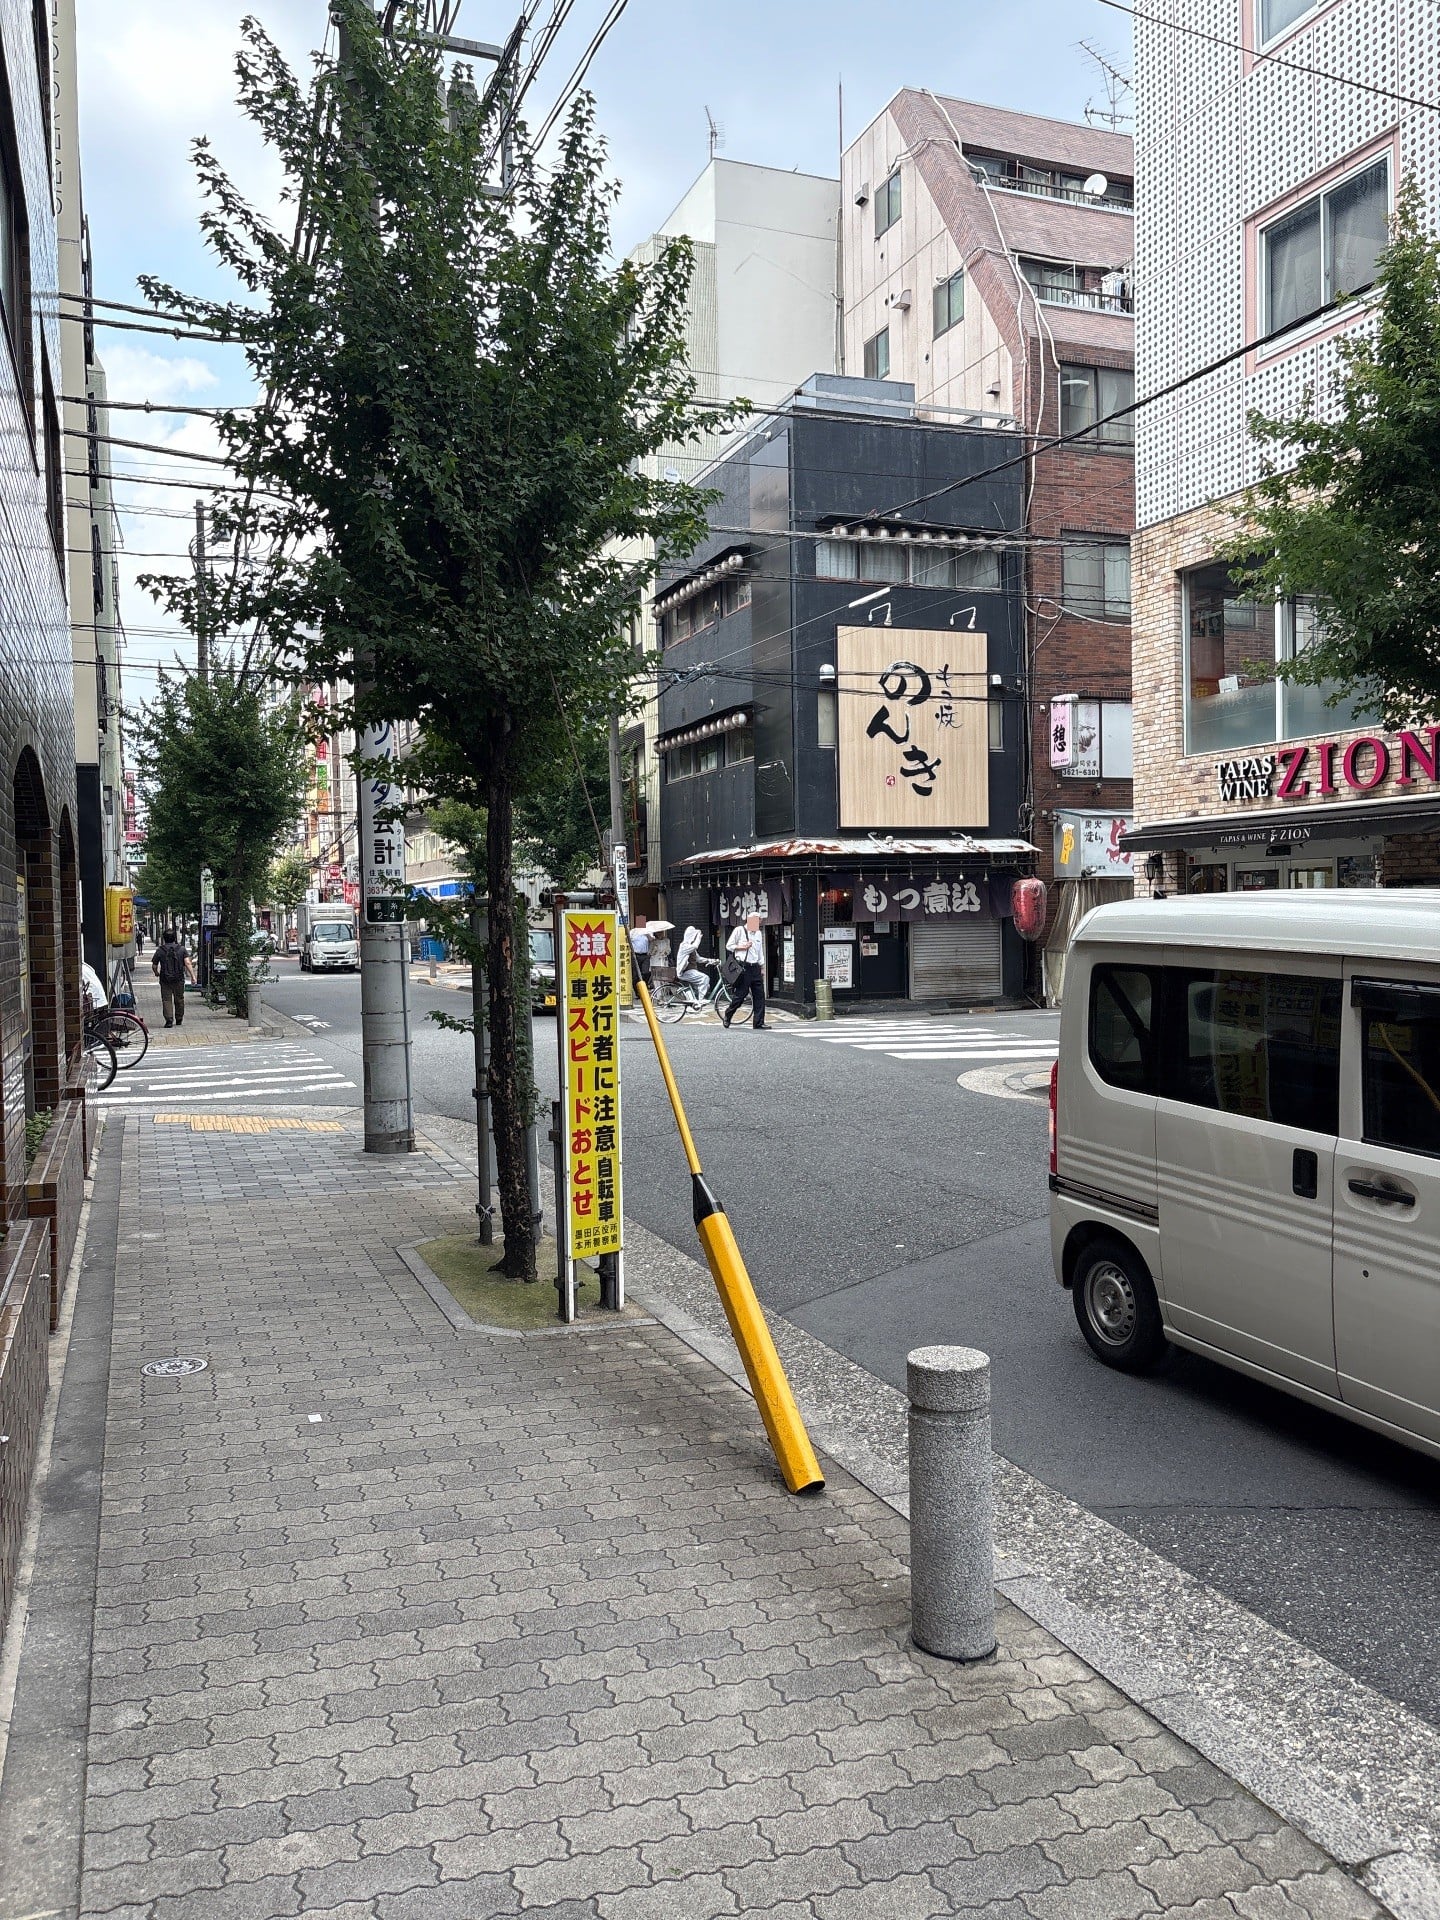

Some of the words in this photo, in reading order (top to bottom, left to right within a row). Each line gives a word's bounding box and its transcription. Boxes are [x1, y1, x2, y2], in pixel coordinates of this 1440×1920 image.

[866, 660, 941, 797] のんき
[1052, 723, 1067, 752] 憩
[1215, 756, 1273, 781] TAPAS
[1277, 726, 1440, 798] ZION
[1218, 779, 1270, 801] WINE
[1220, 835, 1240, 843] TAPAS
[1247, 832, 1266, 841] WINE
[1279, 827, 1311, 841] ZION
[367, 886, 403, 895] 3631-3
[863, 882, 981, 914] もつ煮込
[575, 933, 607, 956] 注意
[592, 975, 616, 1153] 歩行者に注意
[597, 1156, 615, 1222] 自転車
[575, 1223, 618, 1240] 墨田区役所
[575, 1233, 618, 1250] 本所警察署
